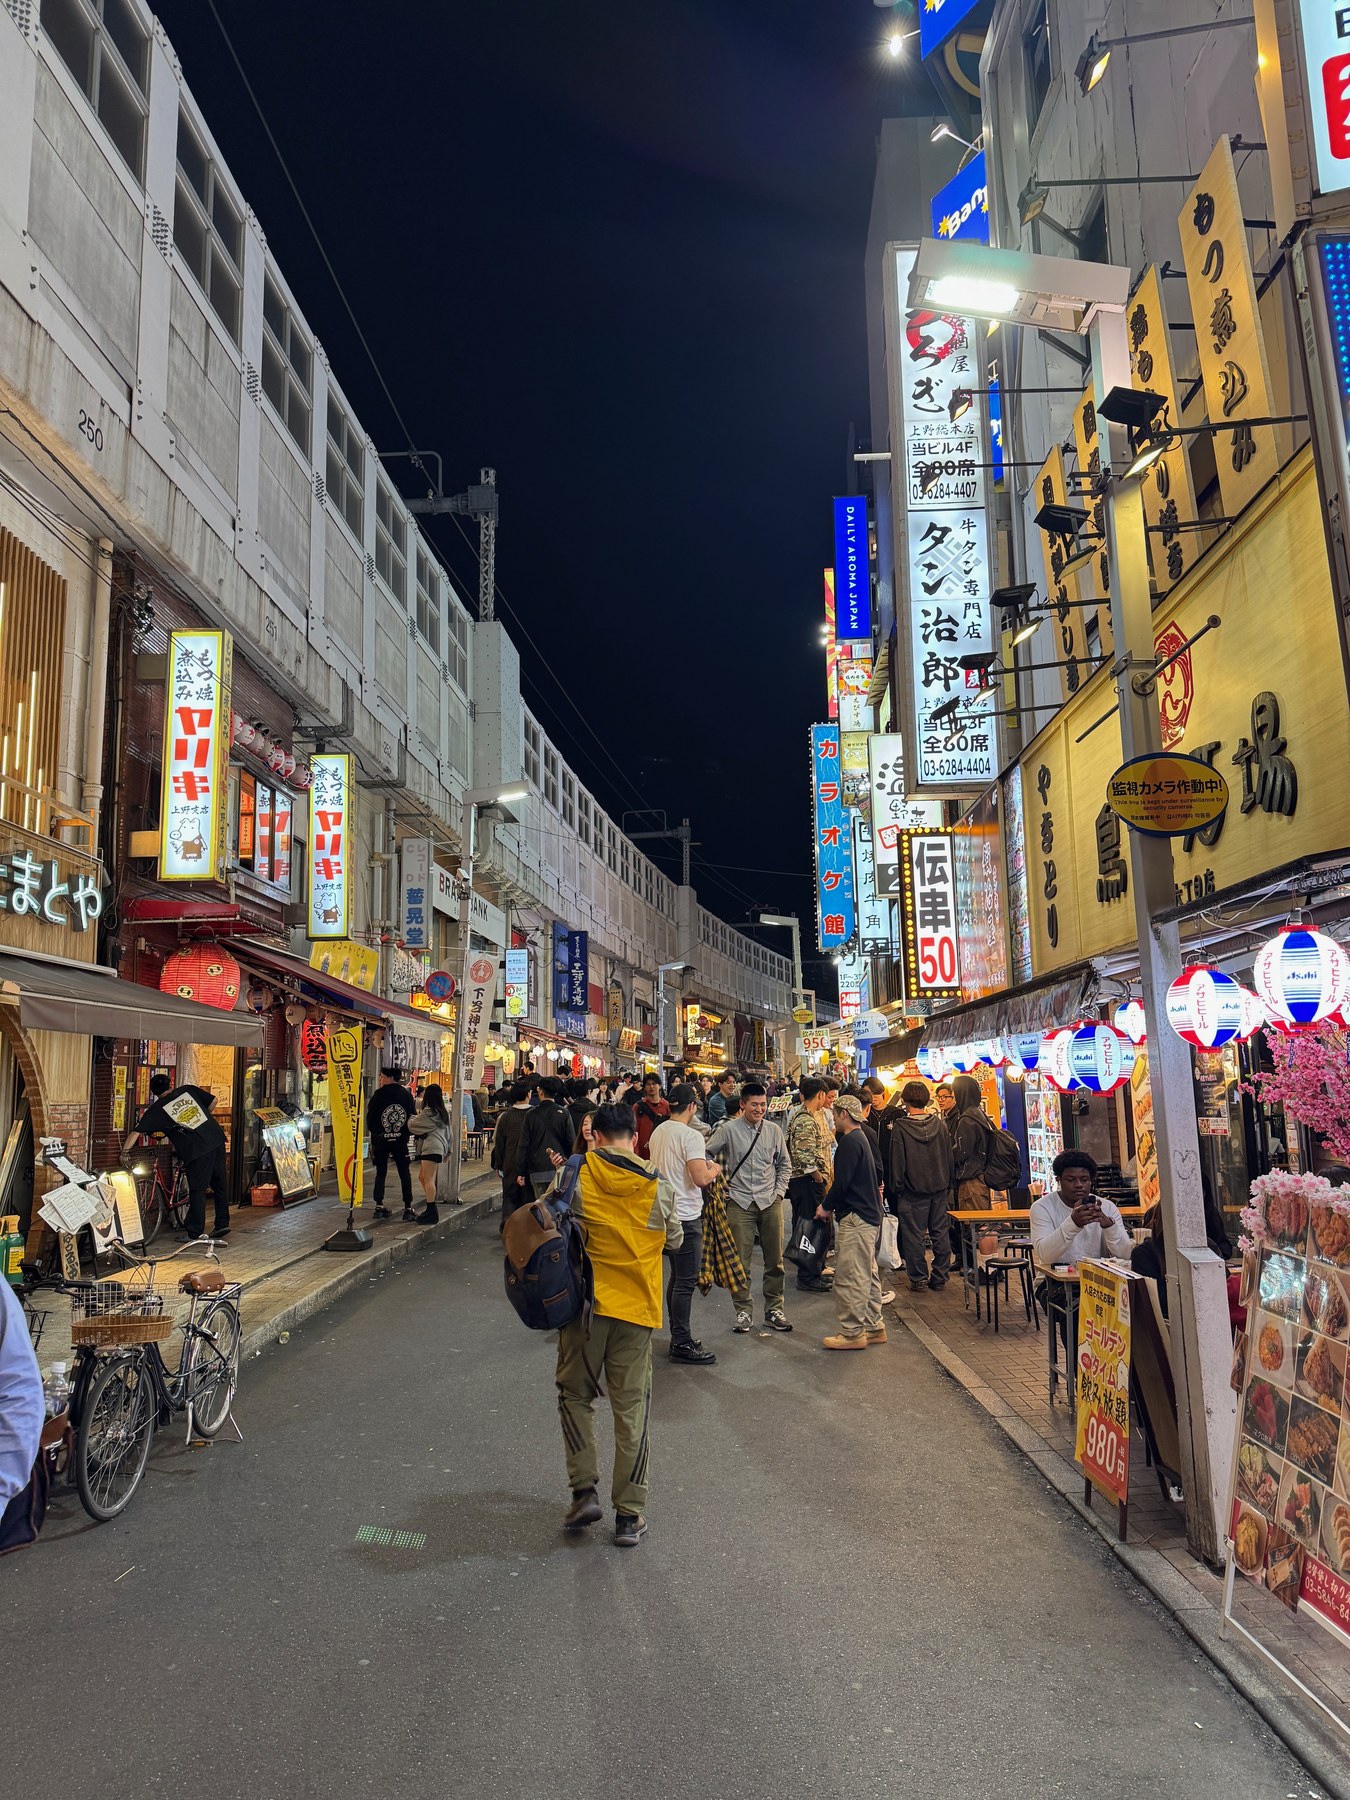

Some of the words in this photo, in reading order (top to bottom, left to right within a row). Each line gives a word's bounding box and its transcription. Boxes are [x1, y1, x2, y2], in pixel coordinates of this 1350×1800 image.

[78, 409, 103, 452] 250
[909, 423, 976, 438] 上野総本店
[911, 441, 974, 457] 当ビル4F
[911, 459, 976, 480] 全80席
[912, 482, 978, 500] 03-6284-4407
[846, 506, 855, 543] DAILY
[847, 546, 857, 588] AROMA
[959, 518, 984, 640] 牛タン専門店
[849, 592, 859, 630] JAPAN
[918, 521, 960, 693] タン治郎
[265, 615, 277, 641] 251
[175, 649, 194, 701] 煮込み
[196, 649, 214, 701] もつ焼
[172, 705, 213, 801] ヤリキ
[923, 735, 989, 754] 全80席
[314, 767, 328, 806] 煮込み
[329, 767, 344, 806] もつ焼
[923, 757, 991, 778] 03-6284-4404
[1112, 779, 1223, 797] 監視カメラ作動中!
[171, 804, 210, 816] 上野支店
[314, 810, 343, 881] ヤリキ
[818, 739, 845, 936] カラオケ館
[1037, 763, 1059, 948] やきとり
[417, 844, 426, 883] レコード
[914, 841, 951, 934] 伝串
[405, 888, 425, 945] 蓄晃堂
[919, 936, 956, 985] 50
[1262, 952, 1279, 1005] アサヒビール
[1286, 970, 1318, 981] Asahi
[1326, 949, 1341, 1003] アサヒビール
[1195, 983, 1209, 1029] アサヒビール
[1020, 1038, 1037, 1046] Asahi
[1074, 1053, 1093, 1061] Asahi
[1103, 1036, 1113, 1077] アサヒビール
[768, 1101, 790, 1112] 950
[1084, 1318, 1128, 1360] ゴールデン
[1091, 1357, 1117, 1388] タイム
[1081, 1372, 1128, 1433] 飲み放題
[1086, 1415, 1118, 1477] 980
[1116, 1458, 1126, 1483] 円
